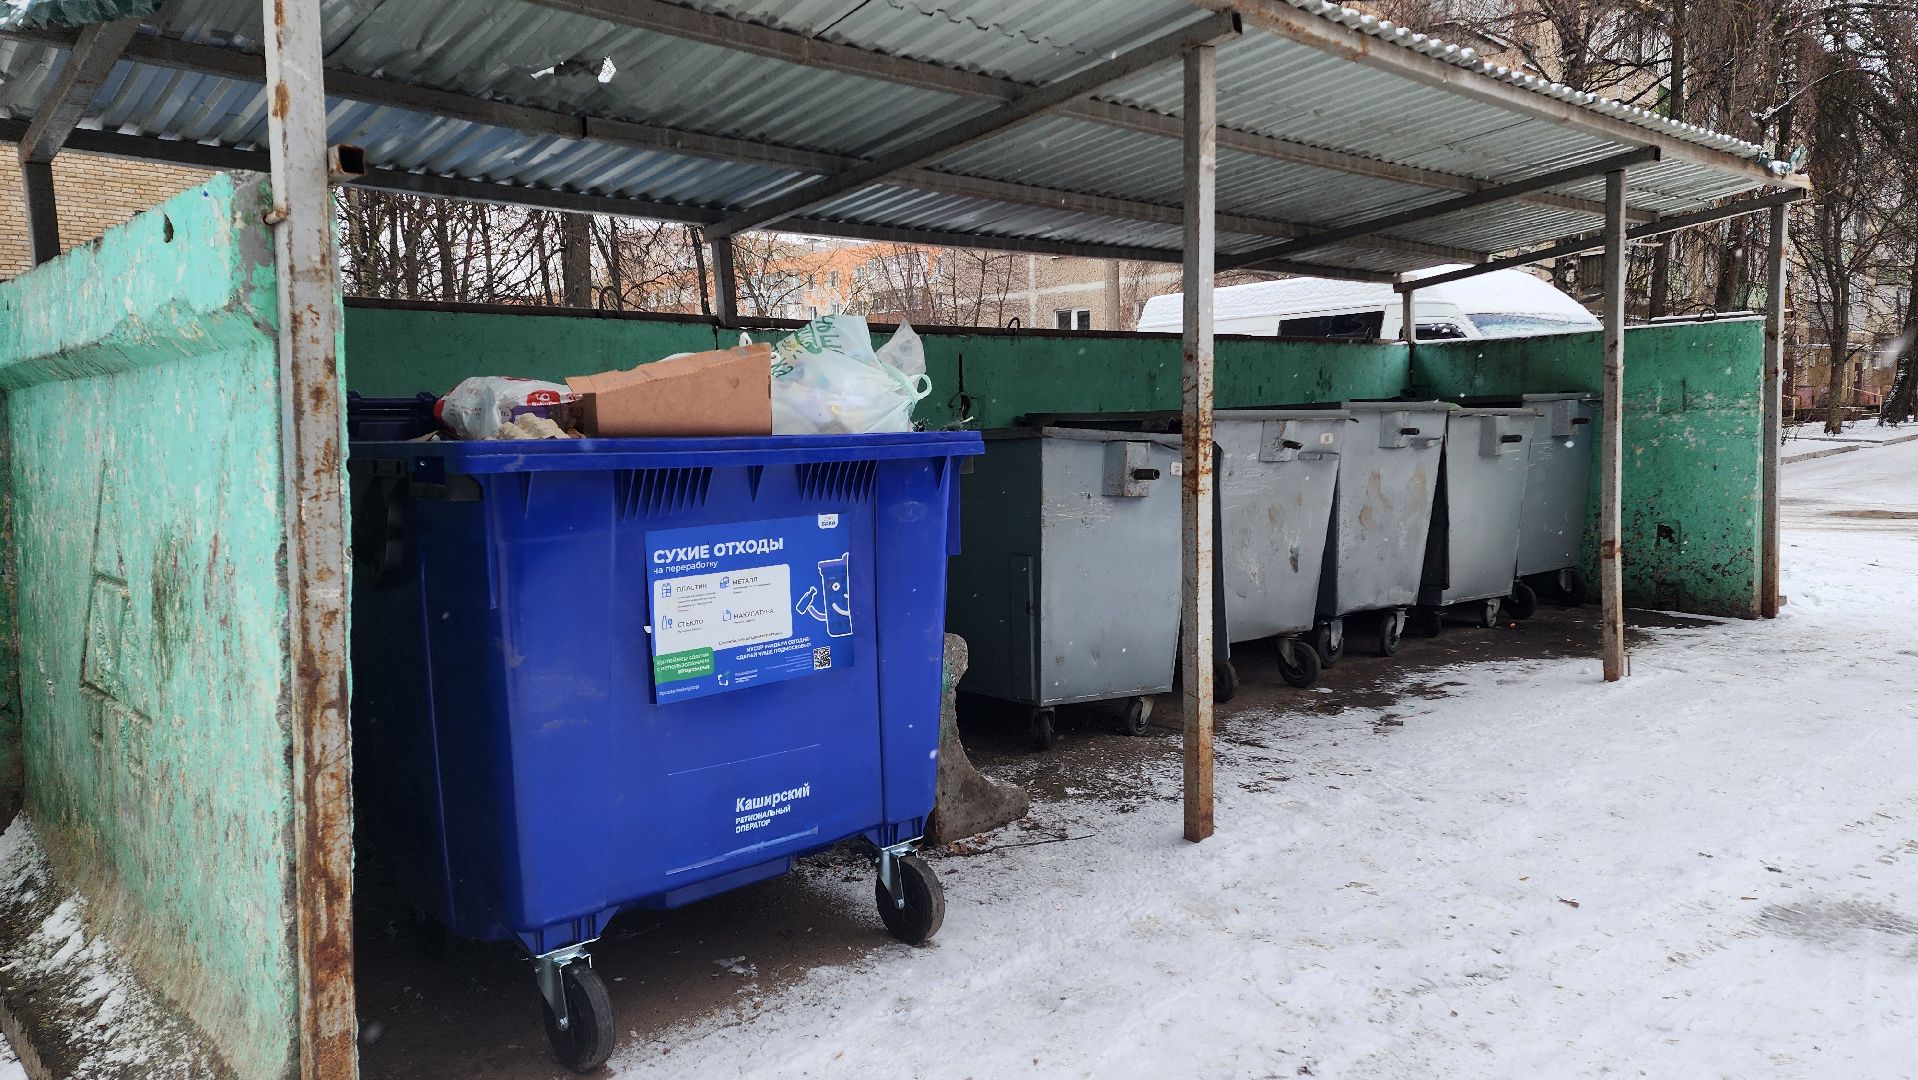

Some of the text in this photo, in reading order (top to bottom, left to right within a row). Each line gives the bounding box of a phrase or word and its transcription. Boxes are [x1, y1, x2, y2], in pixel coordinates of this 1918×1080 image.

[653, 537, 784, 564] СУХИЕ ОТХОДЫ
[653, 560, 719, 575] на переработку
[676, 583, 708, 593] ПЛАСТИК
[677, 619, 704, 628] СТЕКЛО
[735, 782, 810, 813] Каширский
[735, 804, 791, 824] РЕГИОНАЛЬНЫЙ
[735, 819, 771, 834] ОПЕРАТОР
